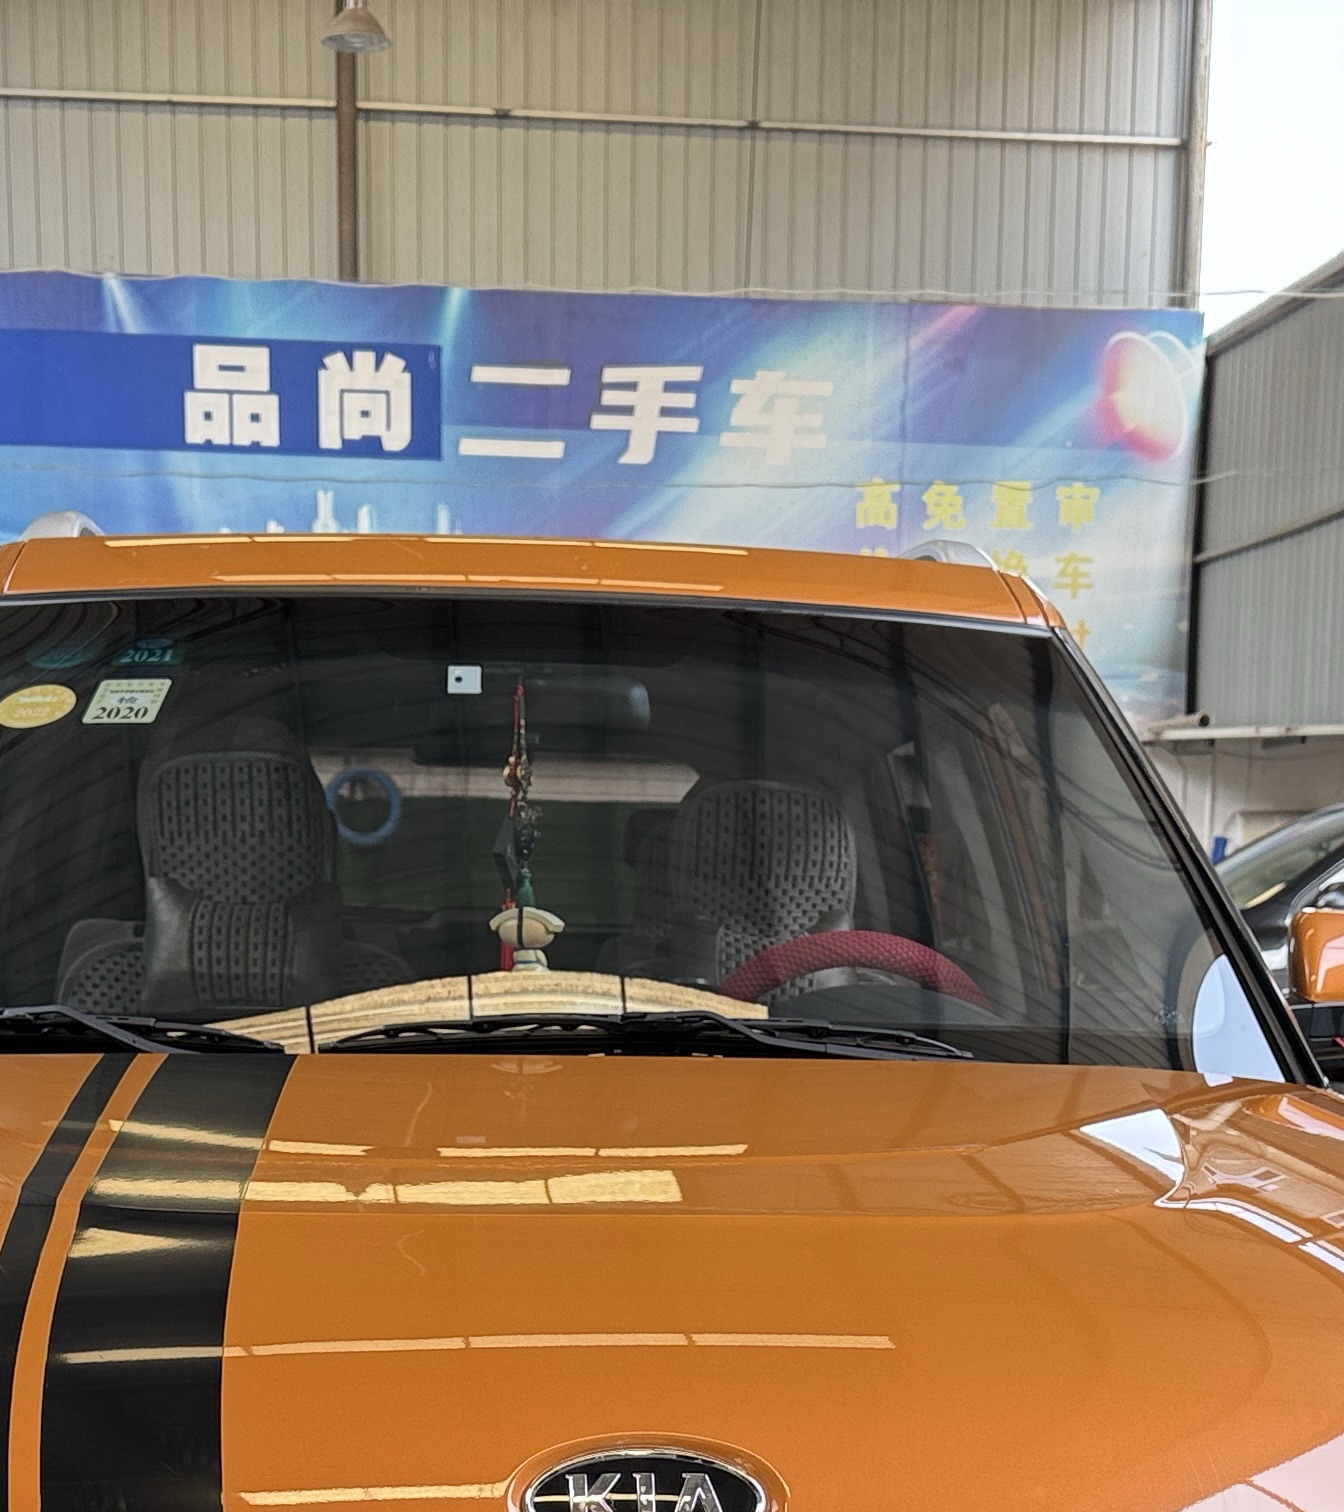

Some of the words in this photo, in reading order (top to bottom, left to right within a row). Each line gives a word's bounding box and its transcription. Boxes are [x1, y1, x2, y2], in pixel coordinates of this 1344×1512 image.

[184, 343, 834, 466] 品尚二手车
[118, 648, 175, 663] 2021
[91, 706, 150, 720] 2020
